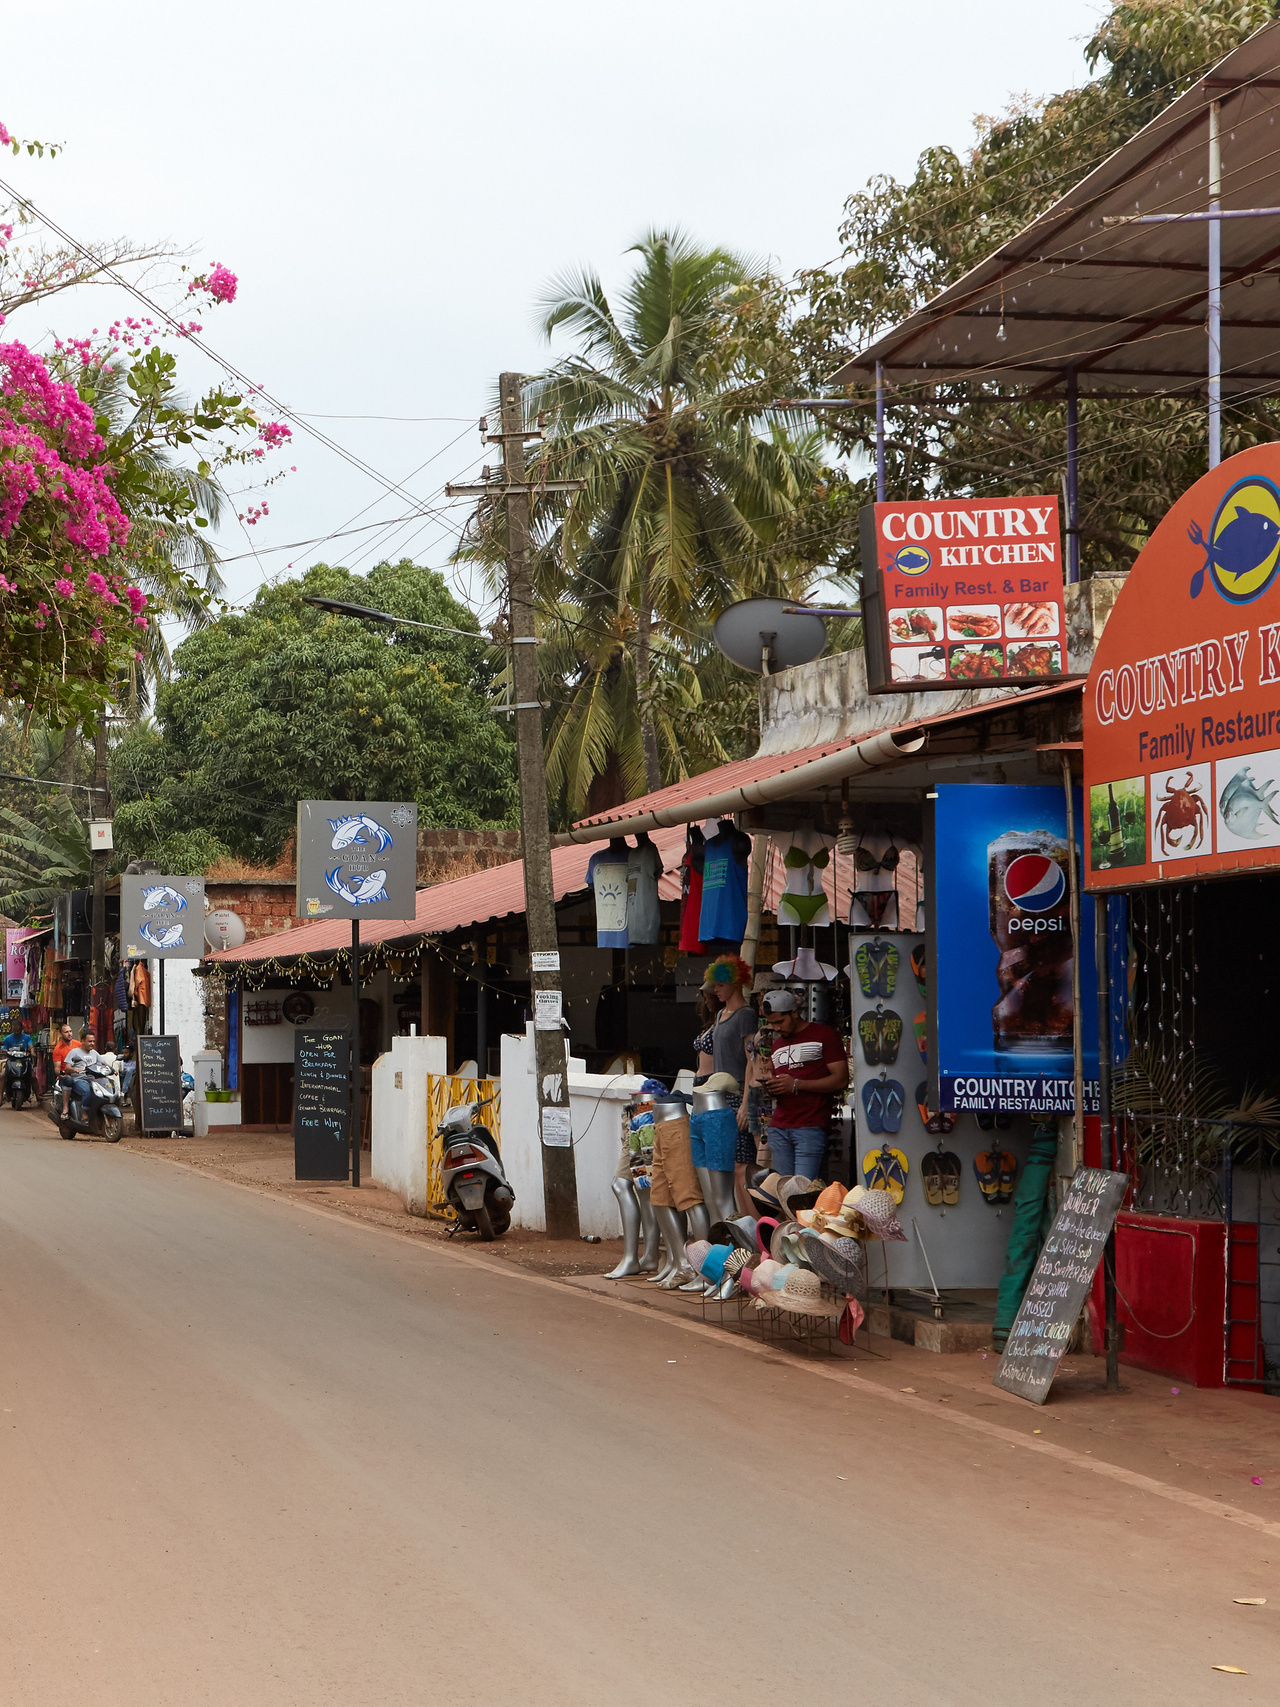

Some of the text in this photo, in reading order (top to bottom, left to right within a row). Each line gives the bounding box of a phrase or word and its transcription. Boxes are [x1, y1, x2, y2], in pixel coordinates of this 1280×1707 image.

[882, 507, 1053, 541] COUNTRY
[939, 542, 1056, 566] KITCHEN
[894, 578, 1049, 600] Family Rest. & Bar
[1096, 630, 1249, 725] COUNTRY
[1139, 722, 1195, 762] Family
[341, 854, 377, 862] GOAN
[348, 864, 369, 872] HUB
[1008, 916, 1063, 934] pepsi
[953, 1078, 1036, 1097] COUNTRY
[953, 1097, 996, 1110] FAMILY
